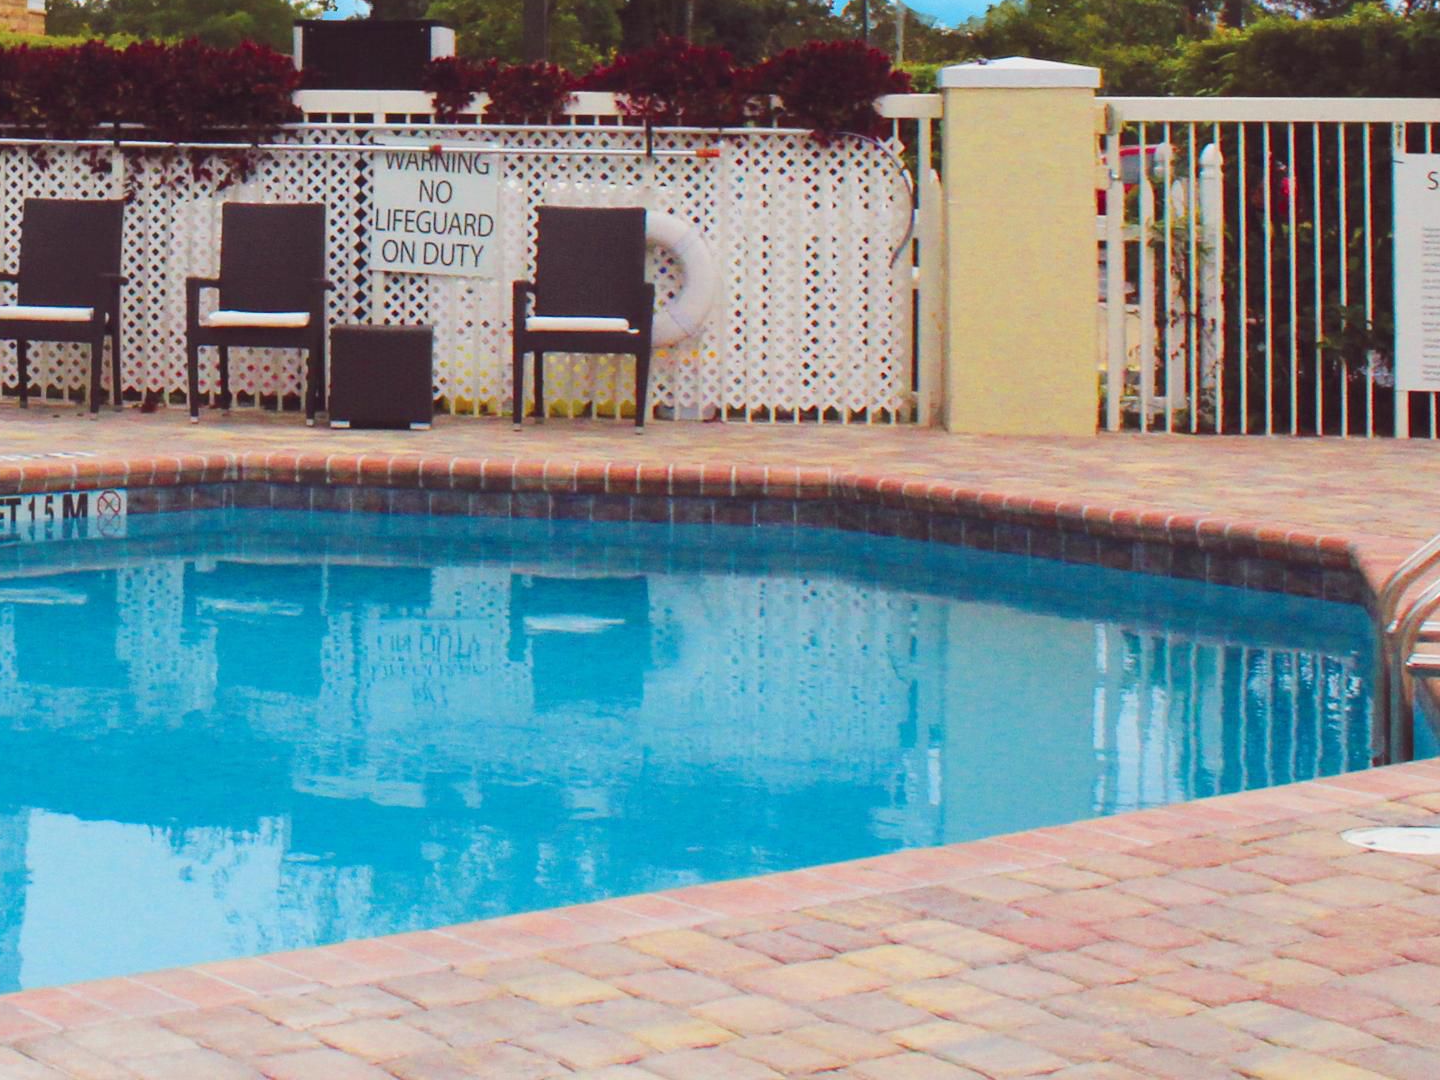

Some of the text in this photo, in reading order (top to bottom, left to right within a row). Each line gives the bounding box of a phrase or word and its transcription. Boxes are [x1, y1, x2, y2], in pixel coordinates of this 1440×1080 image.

[385, 152, 490, 175] WARNING
[419, 180, 453, 204] NO
[375, 208, 494, 237] LIFEGUARD
[382, 239, 484, 268] ON DUTY
[62, 493, 88, 518] M
